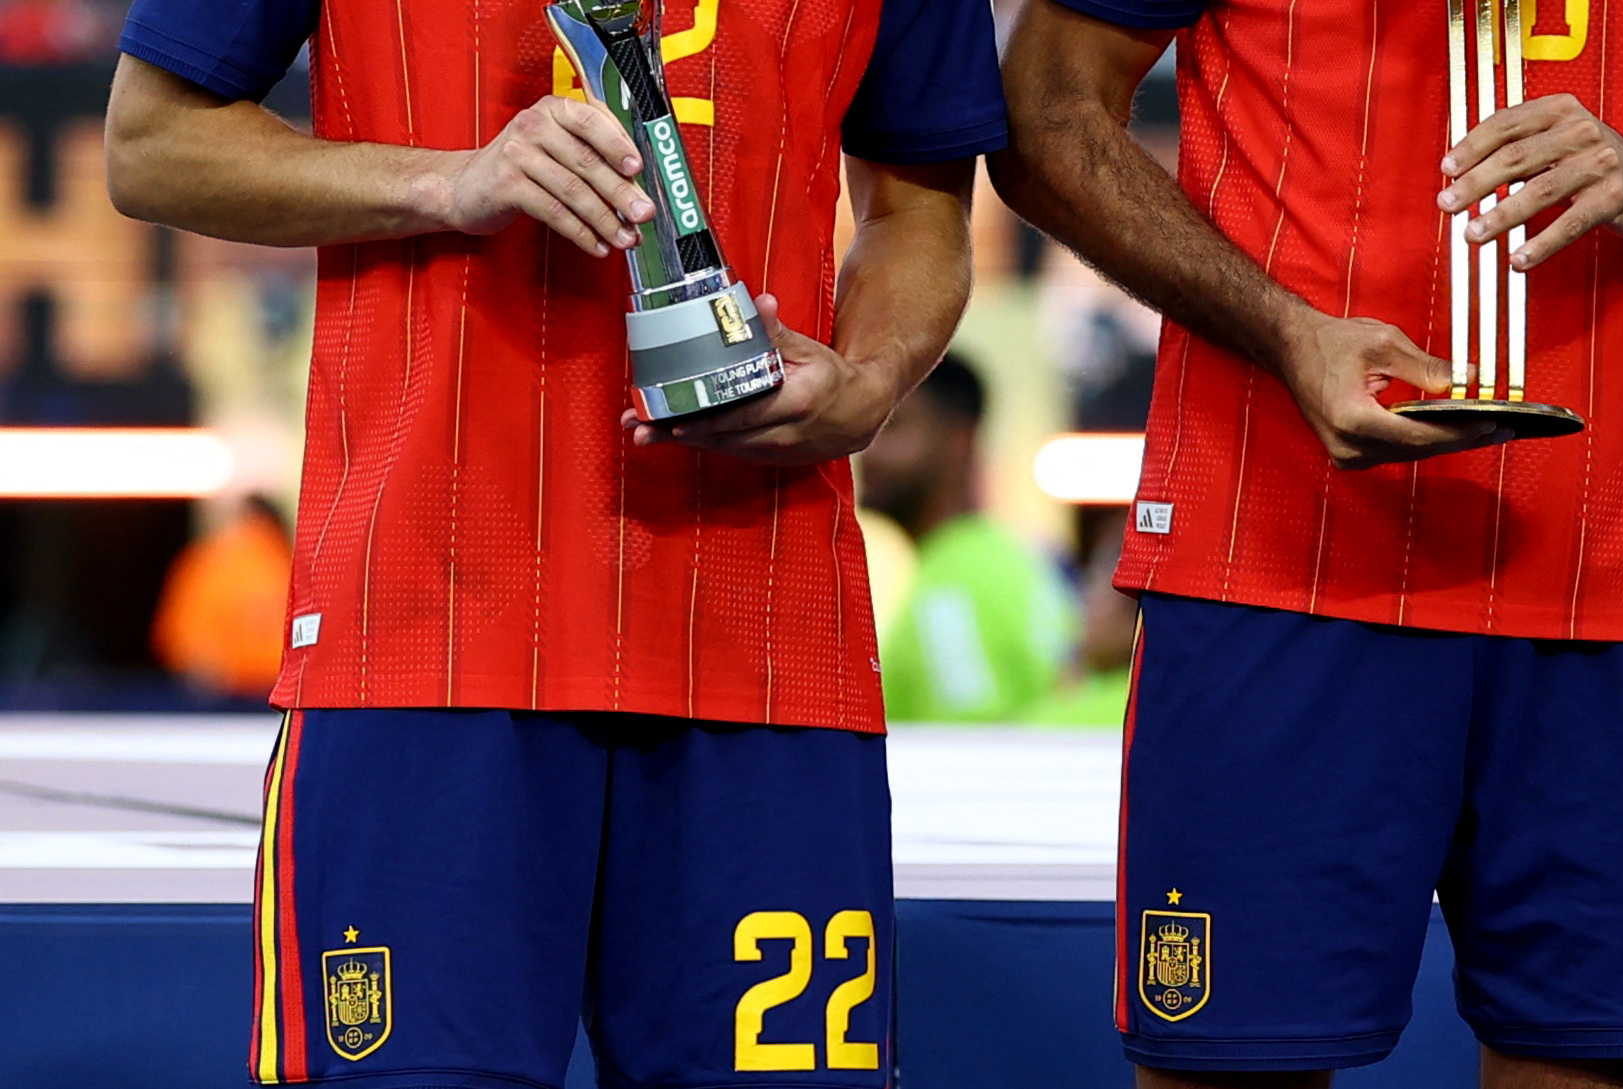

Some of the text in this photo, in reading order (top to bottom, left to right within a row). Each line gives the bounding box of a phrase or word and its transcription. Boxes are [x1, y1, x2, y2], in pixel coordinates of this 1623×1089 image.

[653, 120, 699, 229] aramco
[710, 365, 746, 385] YOUNG
[715, 386, 736, 401] THE
[734, 909, 879, 1072] 22
